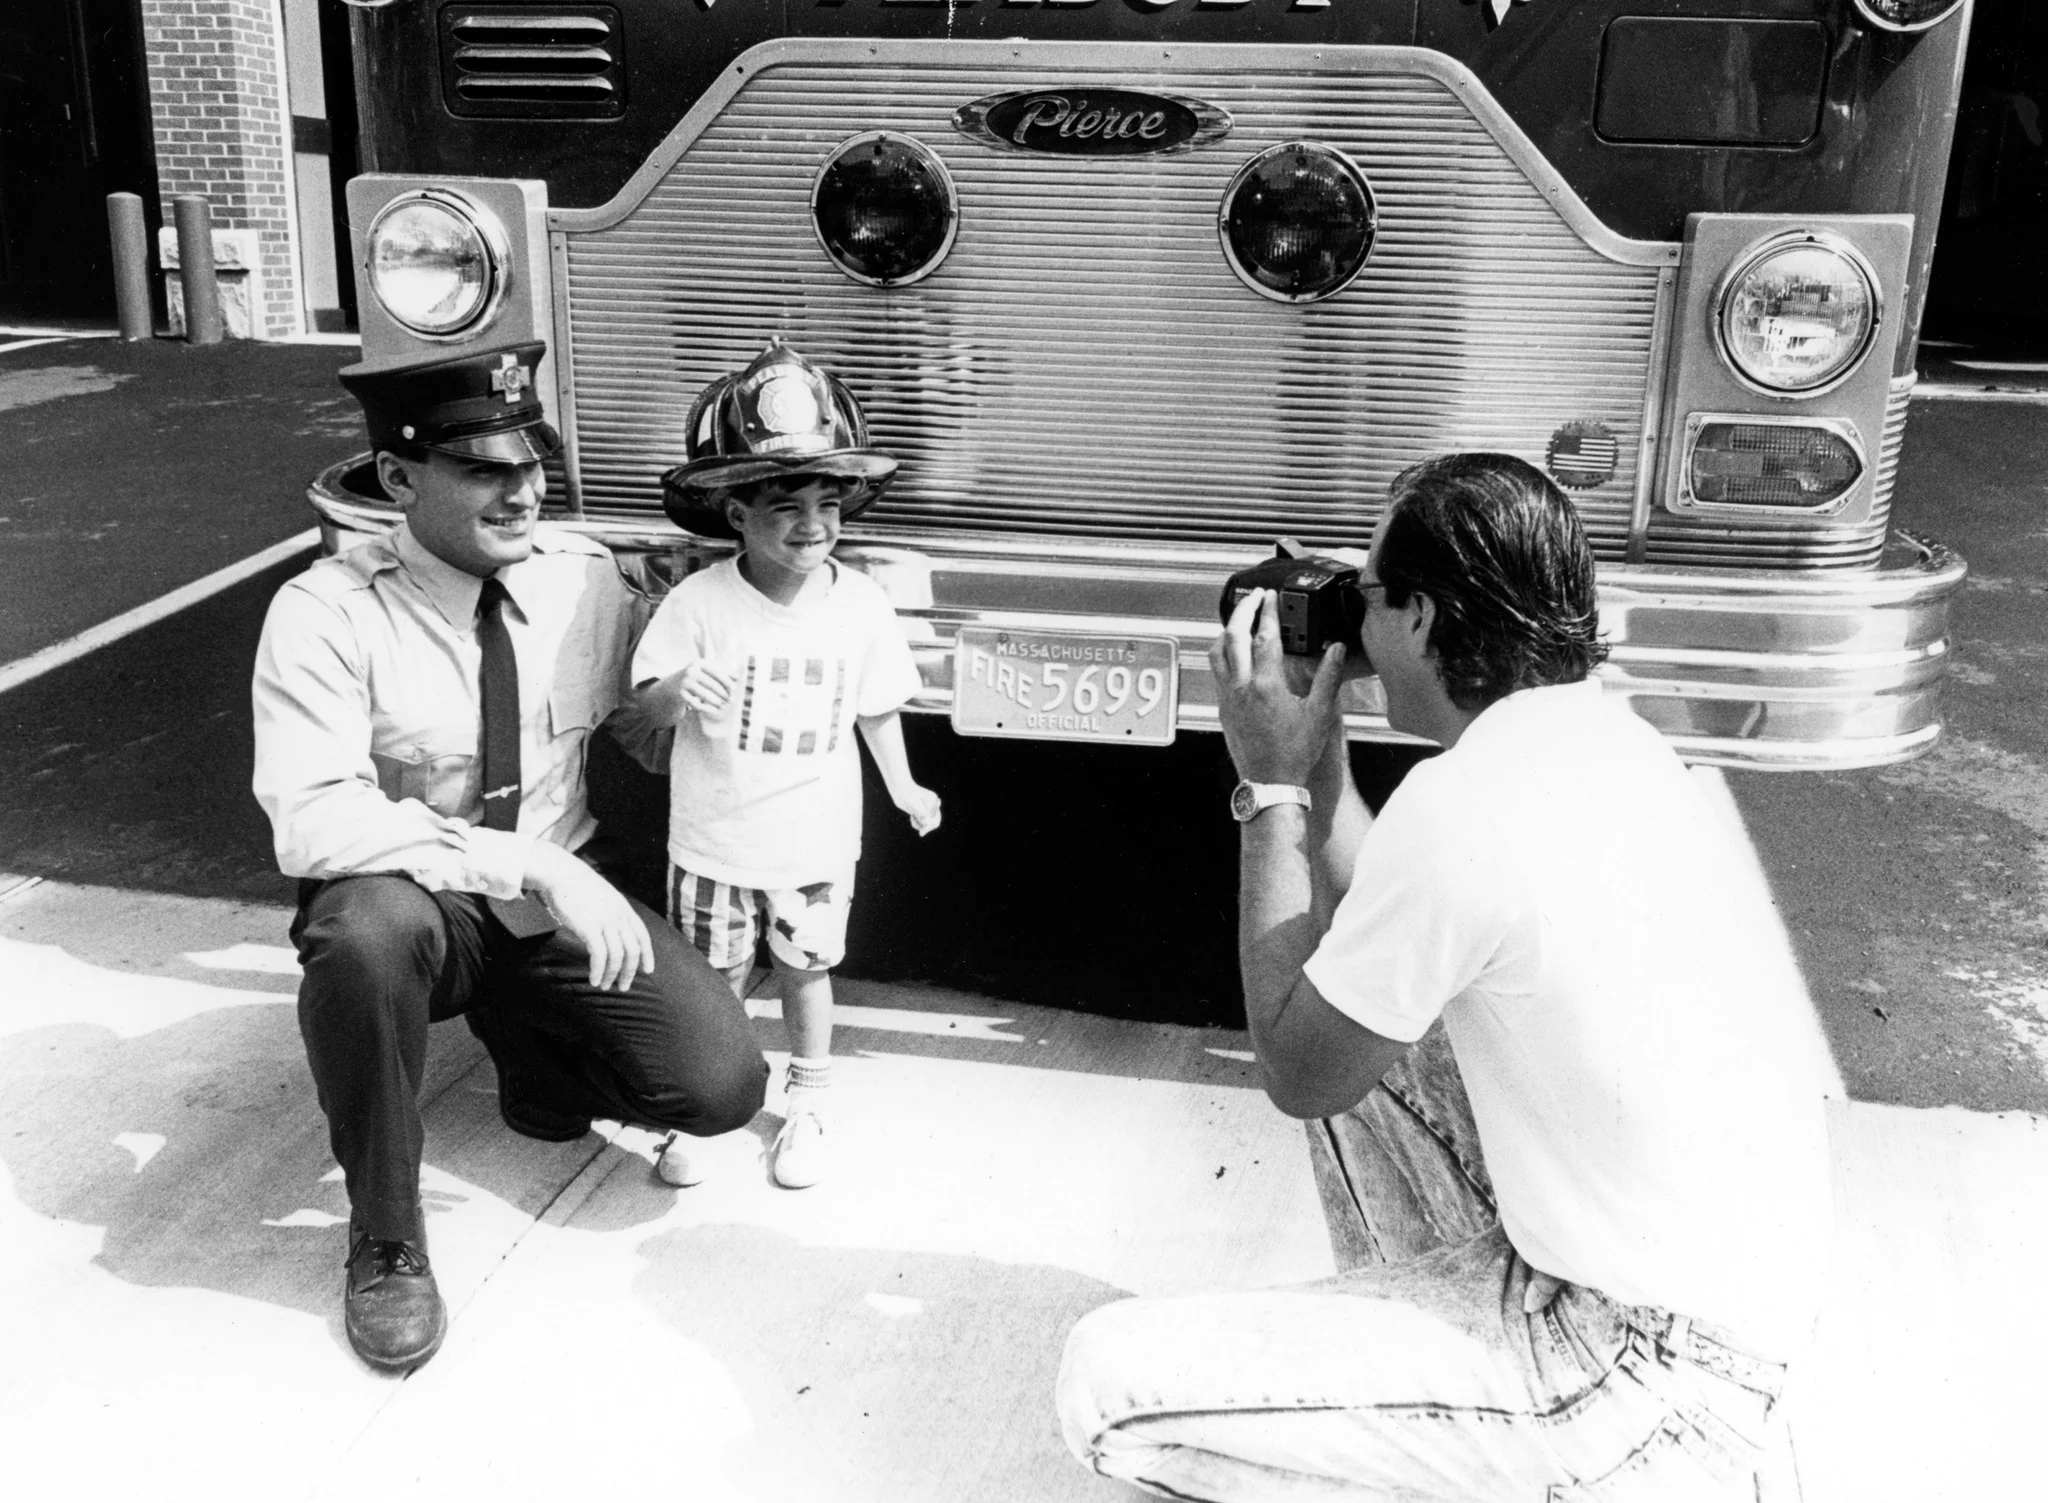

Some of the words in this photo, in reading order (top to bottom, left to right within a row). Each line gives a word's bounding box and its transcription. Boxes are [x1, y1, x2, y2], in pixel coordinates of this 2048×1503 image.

[1012, 94, 1167, 144] Pierce
[996, 642, 1137, 664] MASSACHUSETTS
[970, 647, 1036, 709] FIRE
[1040, 662, 1164, 718] 5699
[1027, 713, 1101, 733] OFFICIAL
